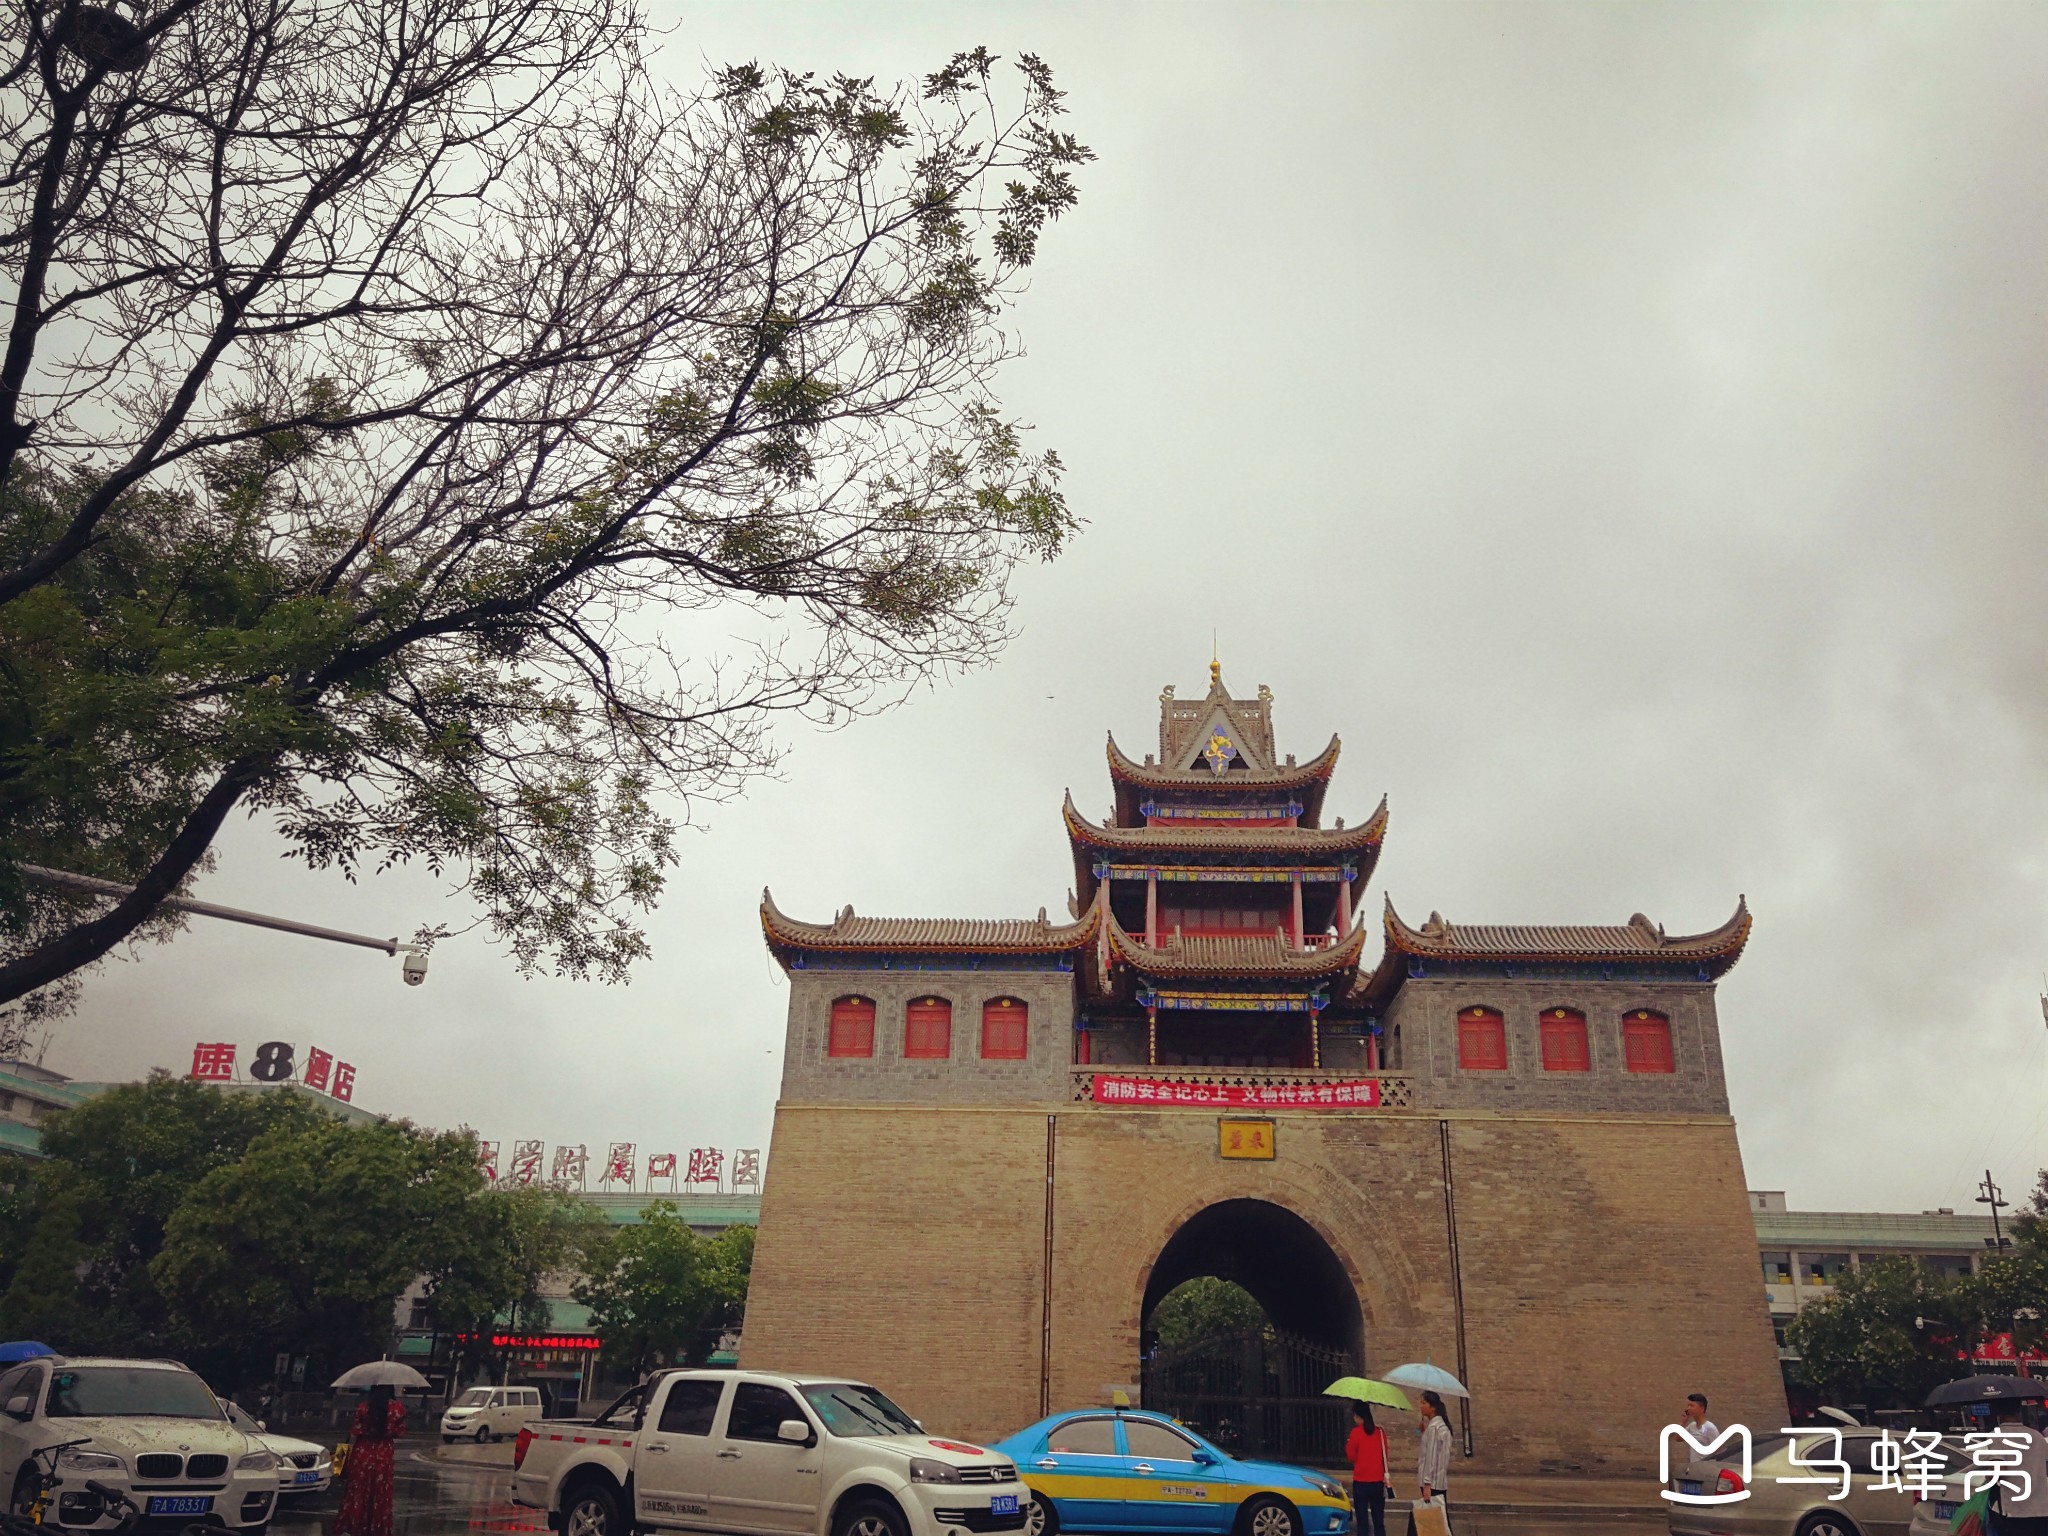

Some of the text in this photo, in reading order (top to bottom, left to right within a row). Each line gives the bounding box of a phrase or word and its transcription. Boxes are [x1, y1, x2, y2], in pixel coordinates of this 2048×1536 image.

[1102, 1080, 1373, 1104] 消防安全记心上 文物传承有保障
